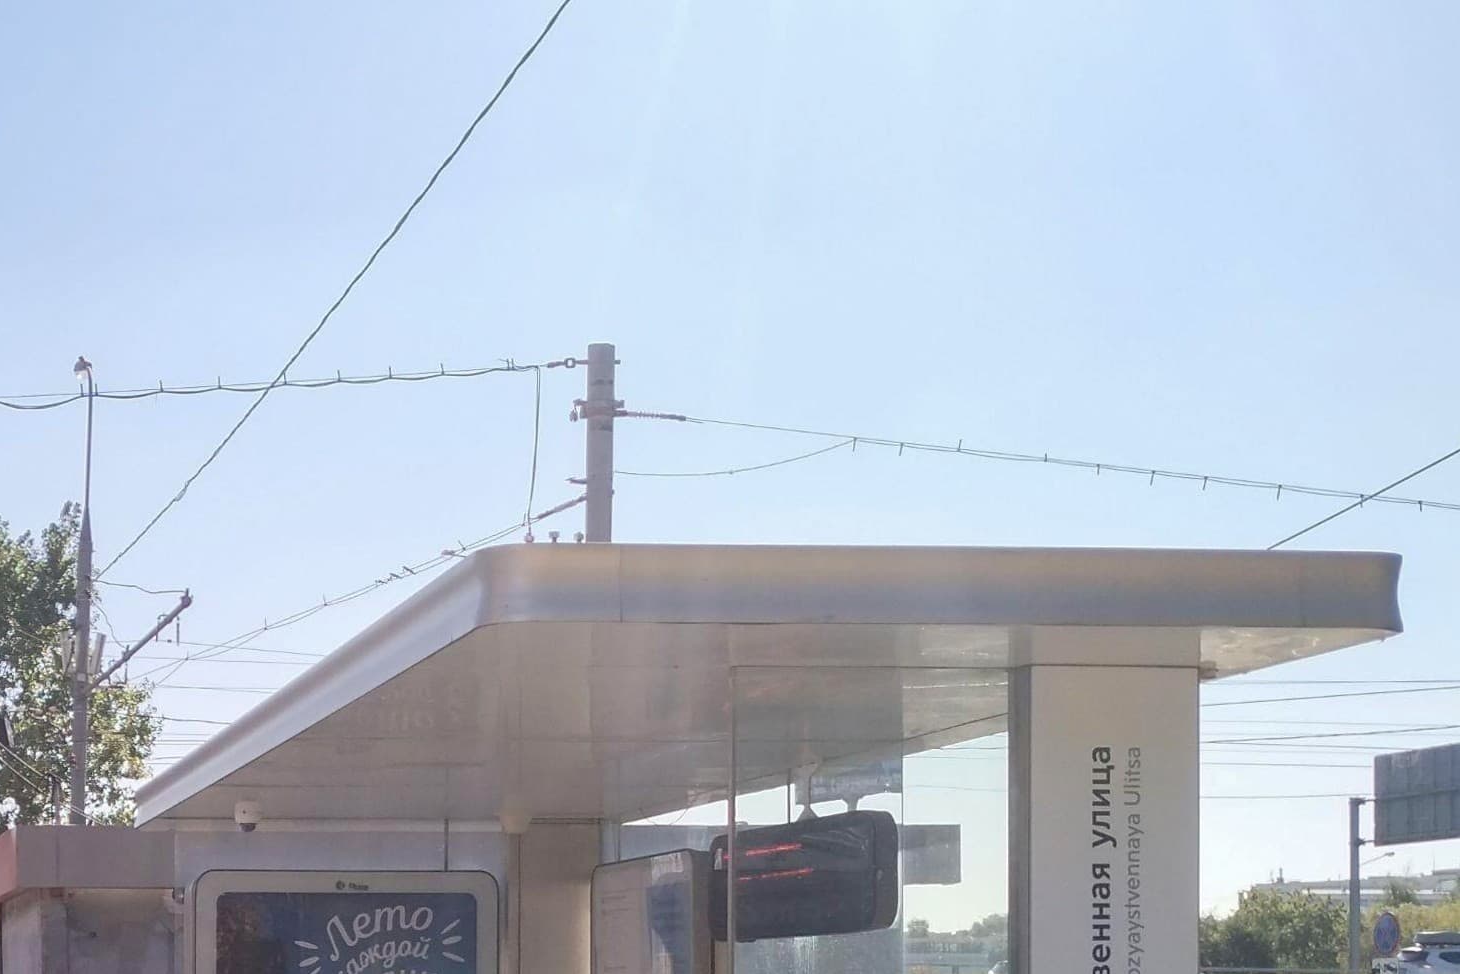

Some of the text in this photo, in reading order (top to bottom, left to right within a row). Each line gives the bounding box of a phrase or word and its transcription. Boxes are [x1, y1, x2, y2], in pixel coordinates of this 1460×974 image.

[1091, 746, 1117, 848] улица
[1123, 746, 1141, 807] Ulitsa
[326, 905, 434, 961] Лето
